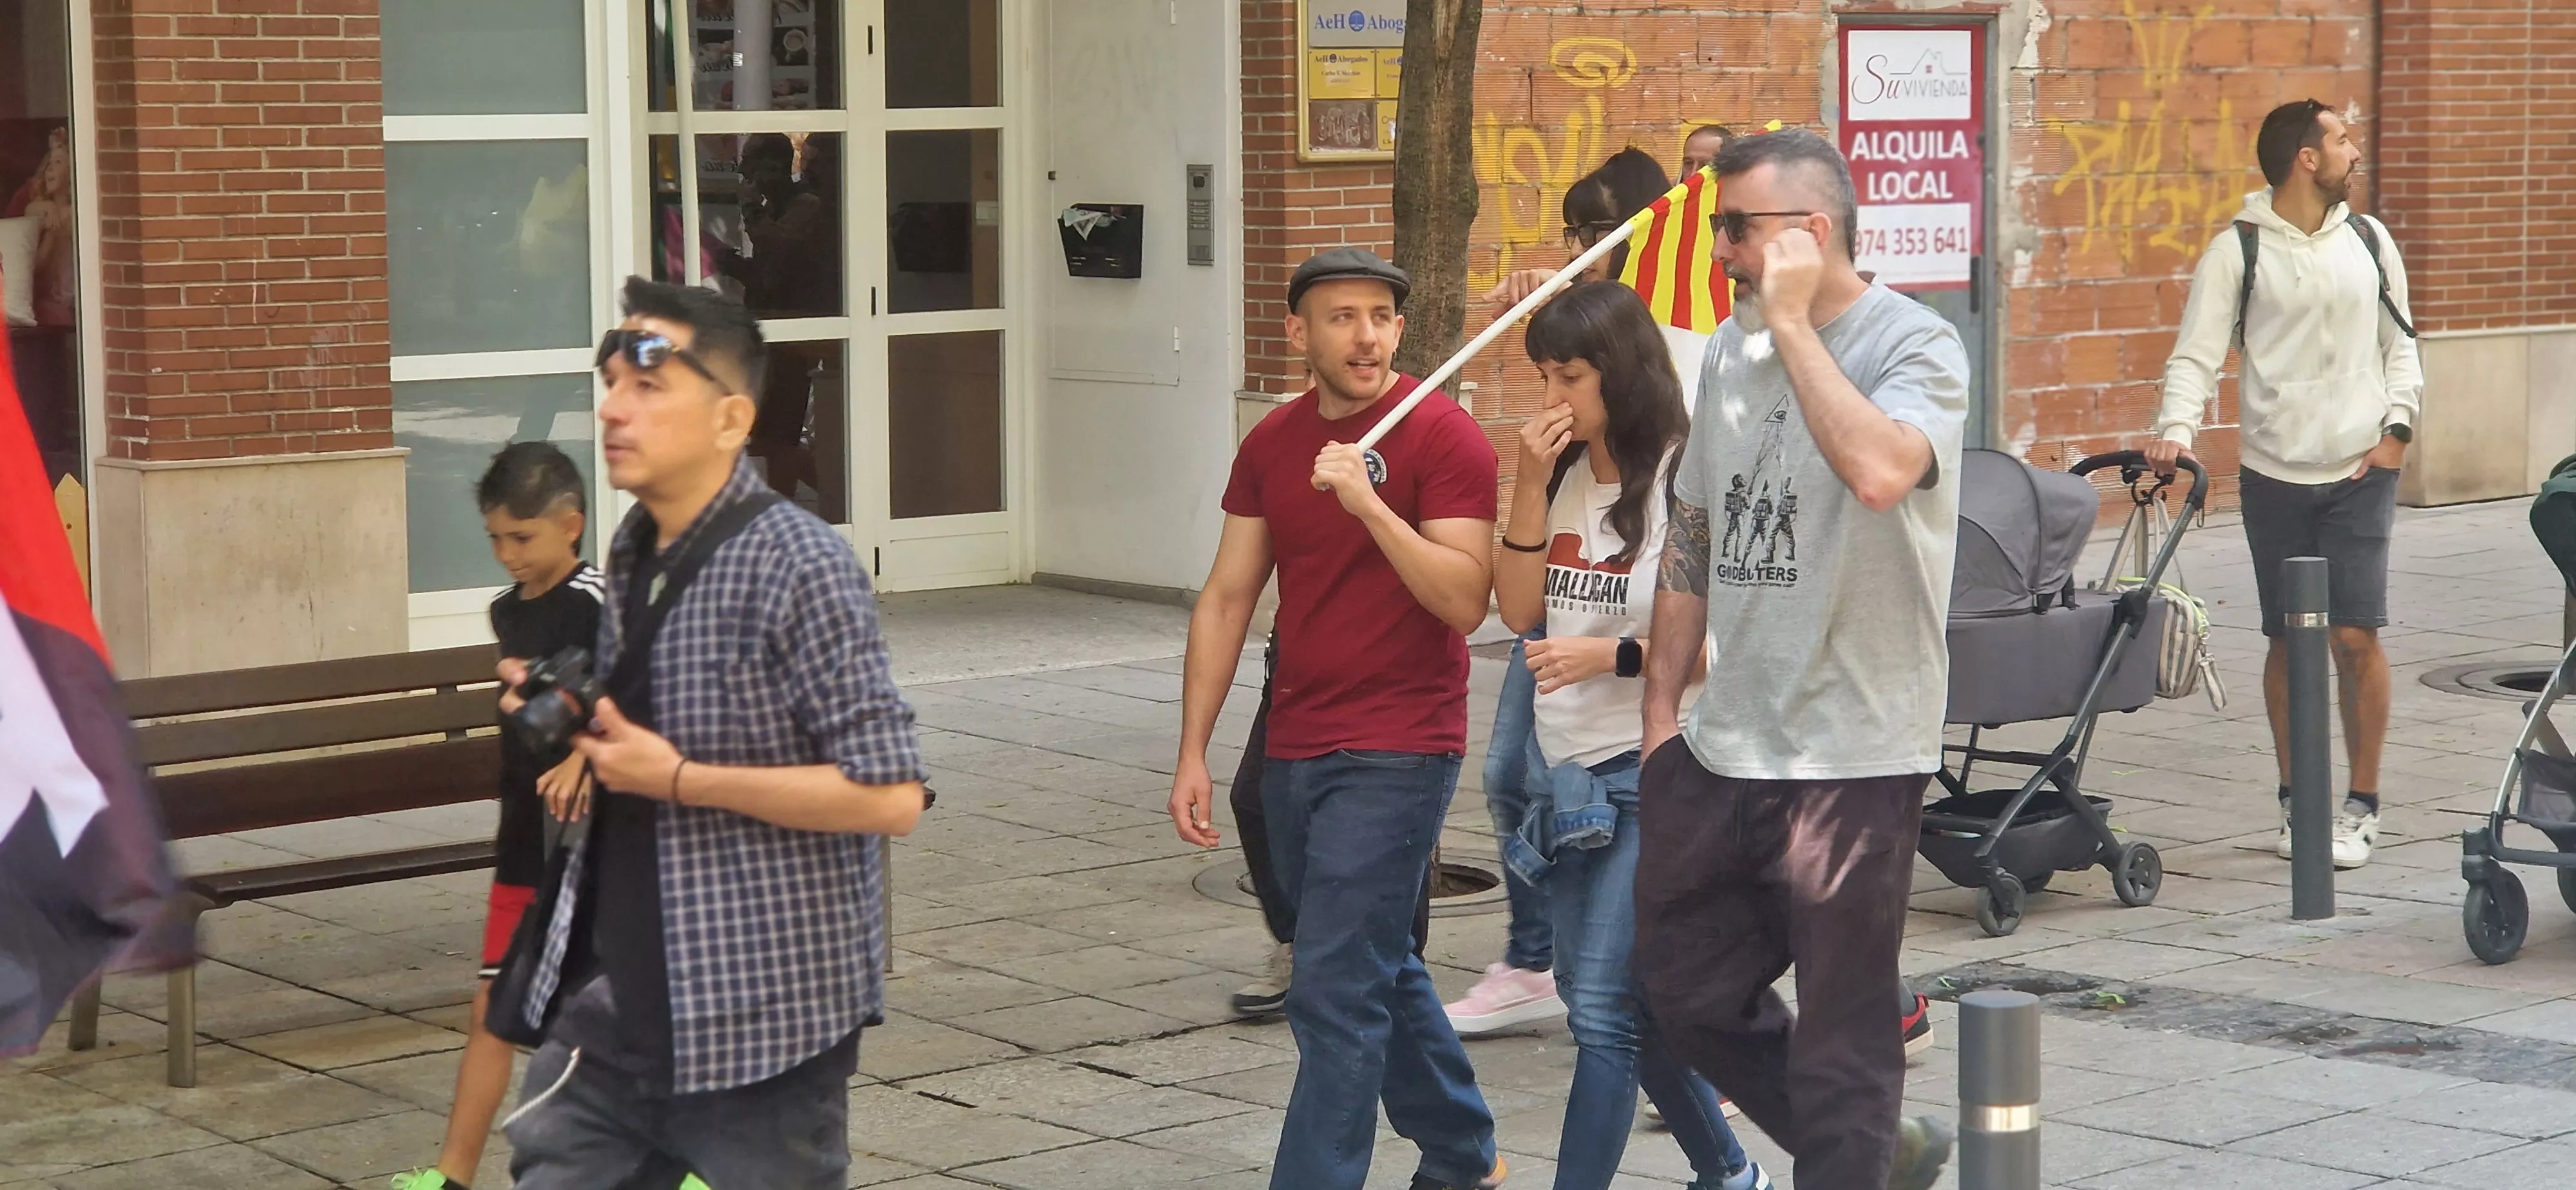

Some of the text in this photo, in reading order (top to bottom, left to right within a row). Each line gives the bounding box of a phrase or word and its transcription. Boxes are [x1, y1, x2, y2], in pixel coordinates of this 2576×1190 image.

[1314, 12, 1406, 33] AeH Abog
[1903, 79, 1968, 98] VIVIENDA
[1850, 130, 1969, 163] ALQUILA
[1868, 171, 1953, 201] LOCAL
[1855, 226, 1968, 257] 974 353 641
